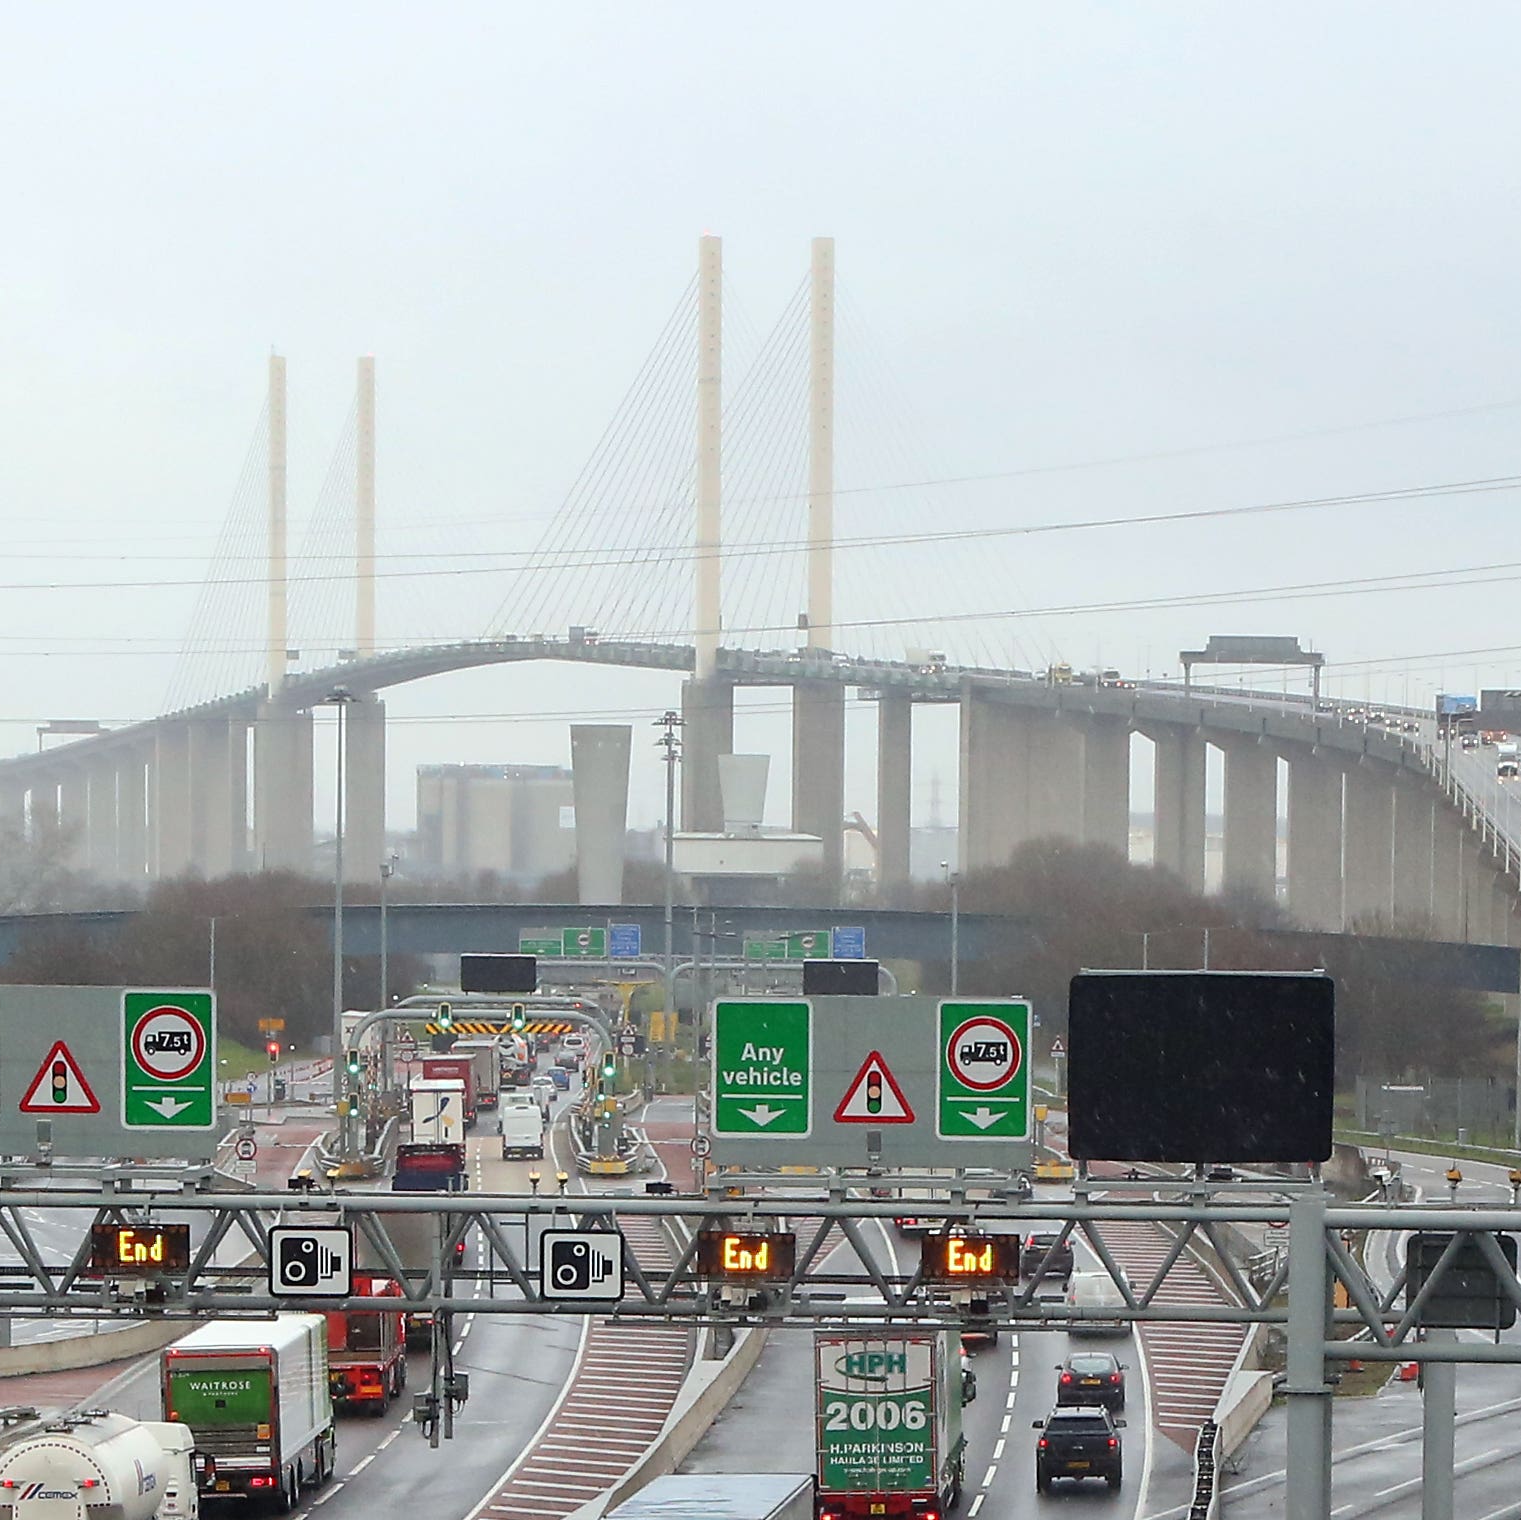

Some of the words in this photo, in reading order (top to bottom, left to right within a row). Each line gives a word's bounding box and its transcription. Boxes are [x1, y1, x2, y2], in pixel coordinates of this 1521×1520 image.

[741, 1043, 784, 1065] Any
[722, 1067, 802, 1087] vehicle
[118, 1231, 163, 1262] End
[724, 1238, 768, 1270] End
[948, 1241, 993, 1273] End
[846, 1354, 906, 1374] HPH
[189, 1380, 251, 1390] WAITROSE
[825, 1401, 927, 1431] 2006
[830, 1456, 879, 1464] HAULAGE
[883, 1455, 924, 1464] LIMITED
[38, 1491, 78, 1500] CEMEX
